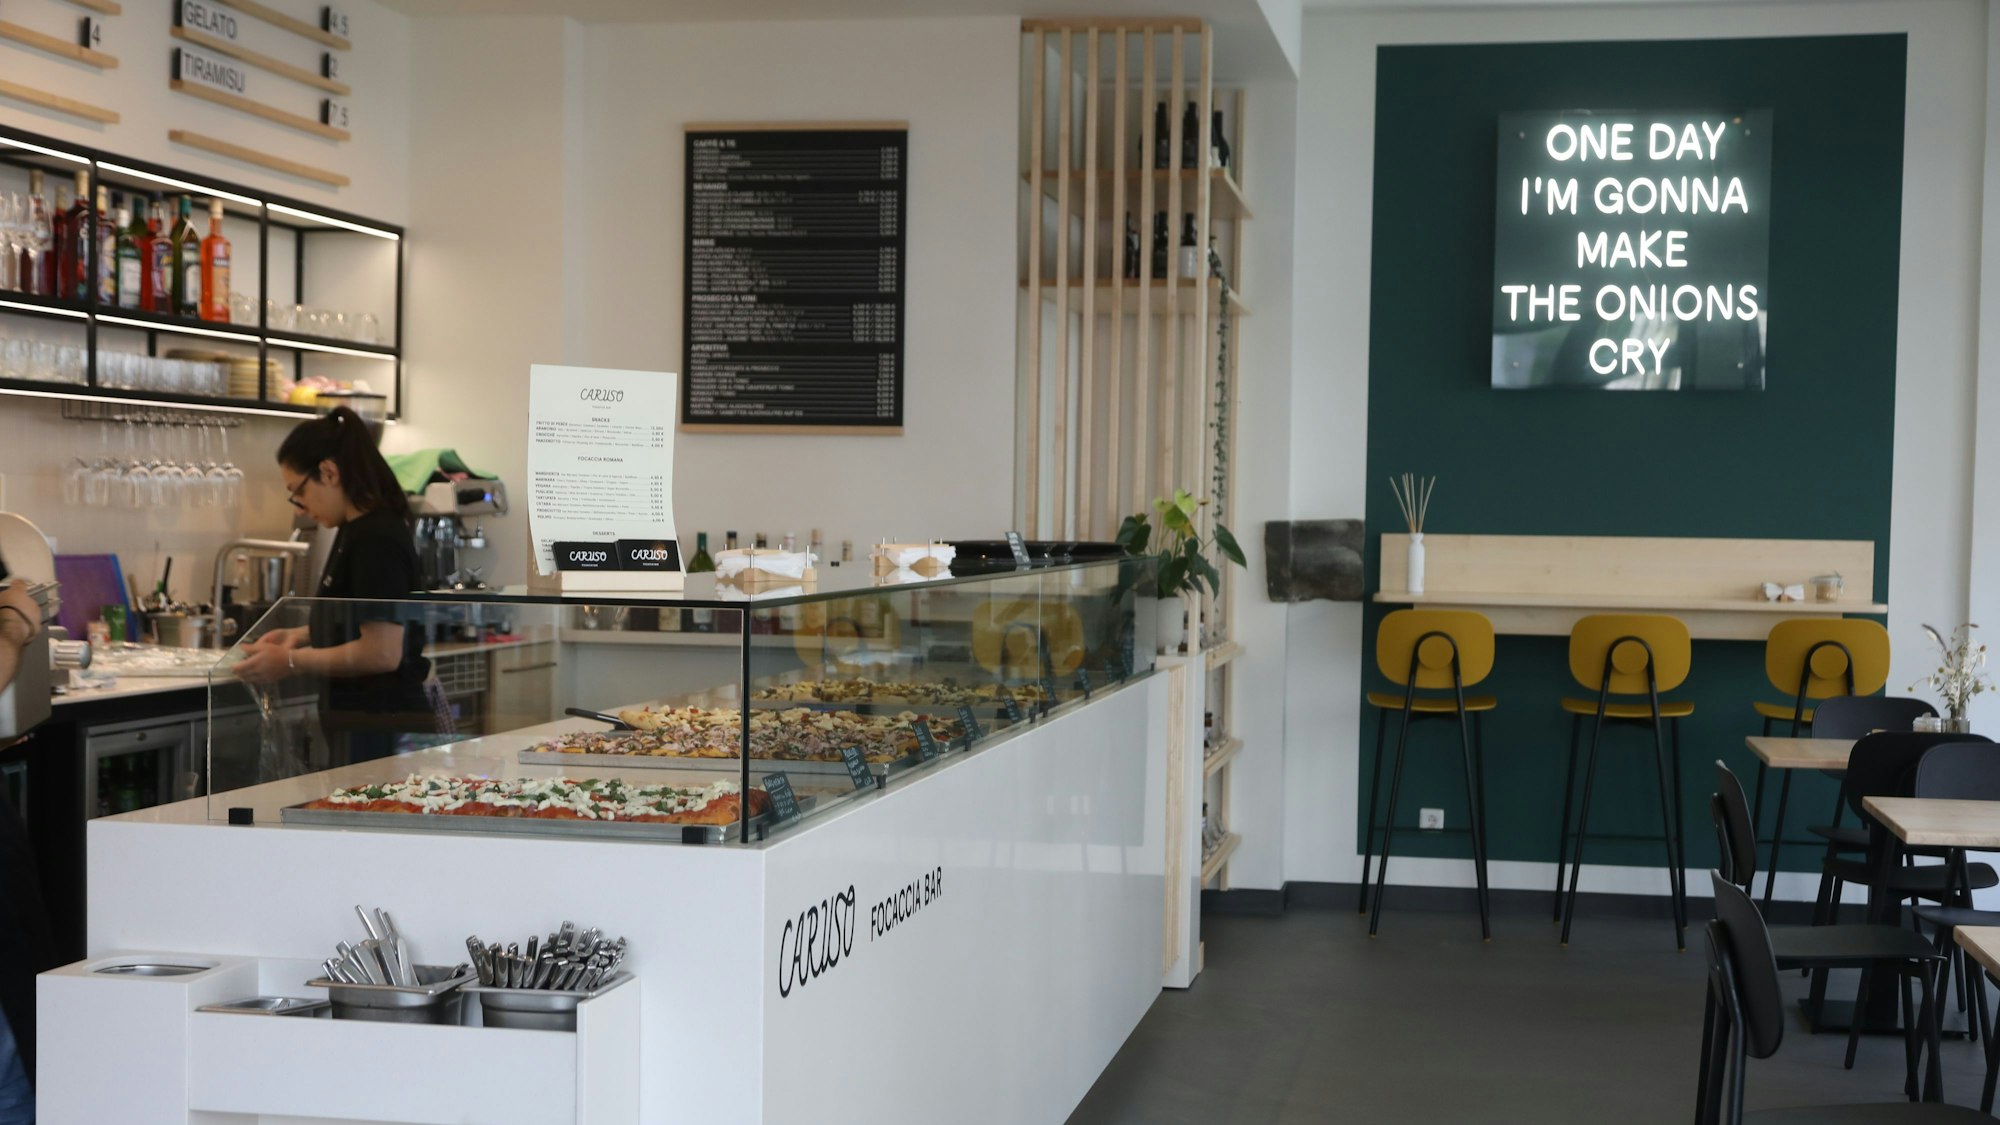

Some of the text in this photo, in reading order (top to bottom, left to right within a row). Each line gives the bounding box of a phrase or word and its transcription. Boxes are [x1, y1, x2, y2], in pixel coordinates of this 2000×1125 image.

[92, 24, 101, 45] 4
[184, 1, 238, 40] GELATO
[183, 52, 246, 93] TIRAMISU
[1546, 121, 1726, 162] ONE DAY
[1520, 175, 1749, 215] I'M GONNA
[1577, 230, 1689, 269] MAKE
[692, 294, 733, 303] PROSECCO
[1501, 284, 1759, 322] THE ONIONS
[1589, 338, 1671, 375] CRY
[580, 388, 624, 402] CARUSO
[569, 551, 607, 562] CARUSO
[631, 549, 668, 560] CARUSO
[779, 866, 942, 999] CARUSO FOCACCIA BAR
